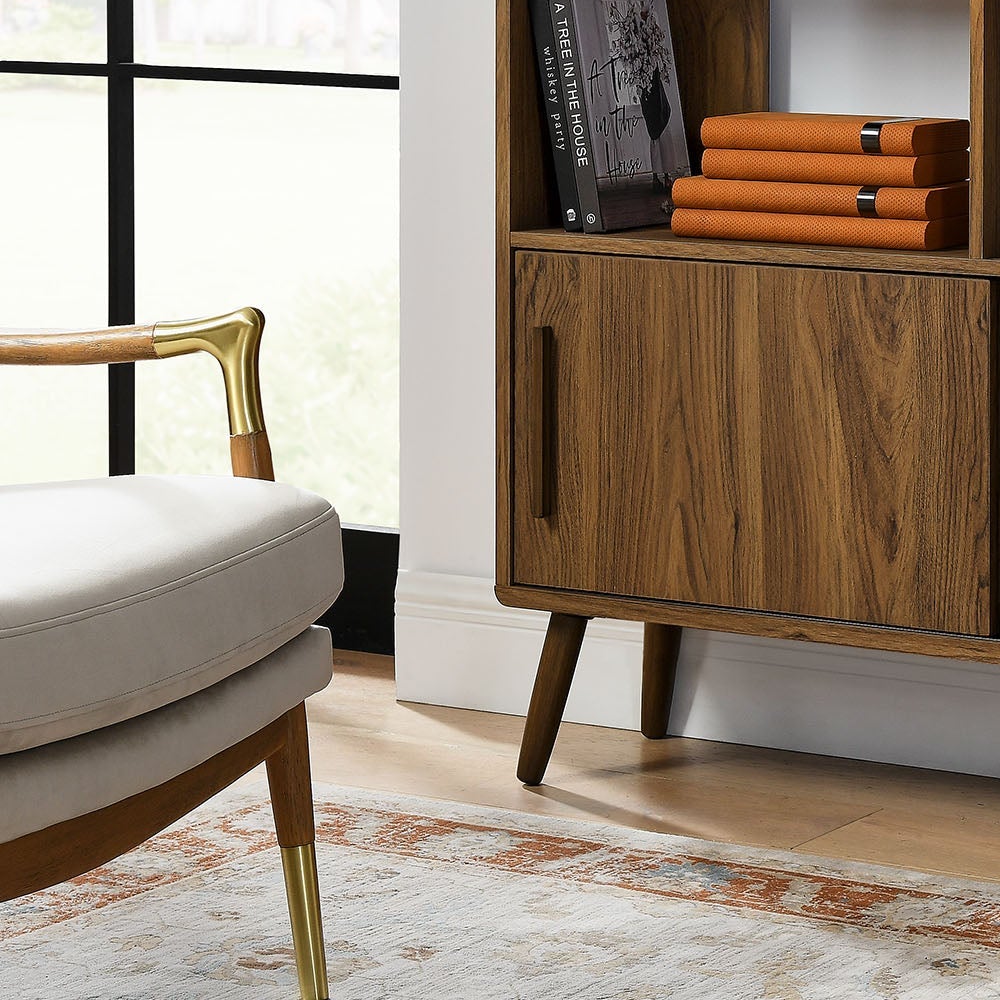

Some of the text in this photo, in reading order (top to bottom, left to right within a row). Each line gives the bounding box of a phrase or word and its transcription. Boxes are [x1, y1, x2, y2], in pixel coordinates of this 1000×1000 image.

[543, 46, 565, 151] whiskey party
[553, 2, 589, 168] A TREE IN THE HOUSE
